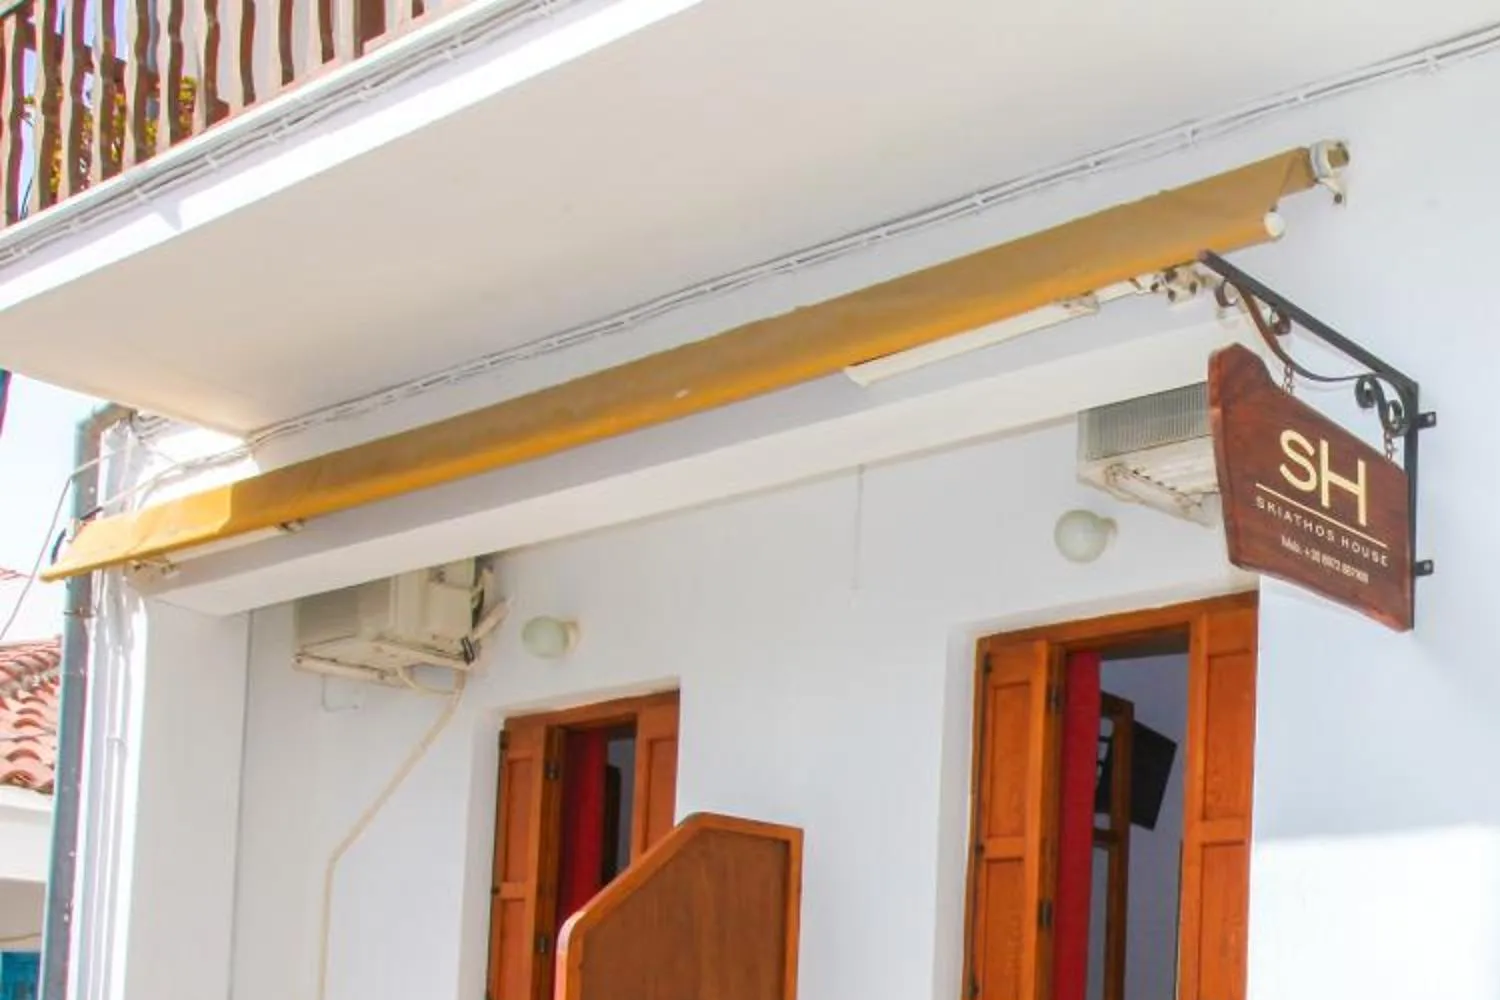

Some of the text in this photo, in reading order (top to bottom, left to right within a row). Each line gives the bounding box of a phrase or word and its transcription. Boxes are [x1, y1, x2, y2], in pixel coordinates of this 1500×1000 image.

[1279, 429, 1367, 526] SH
[1256, 495, 1335, 542] SKIATHOS
[1341, 535, 1389, 568] HOUSE
